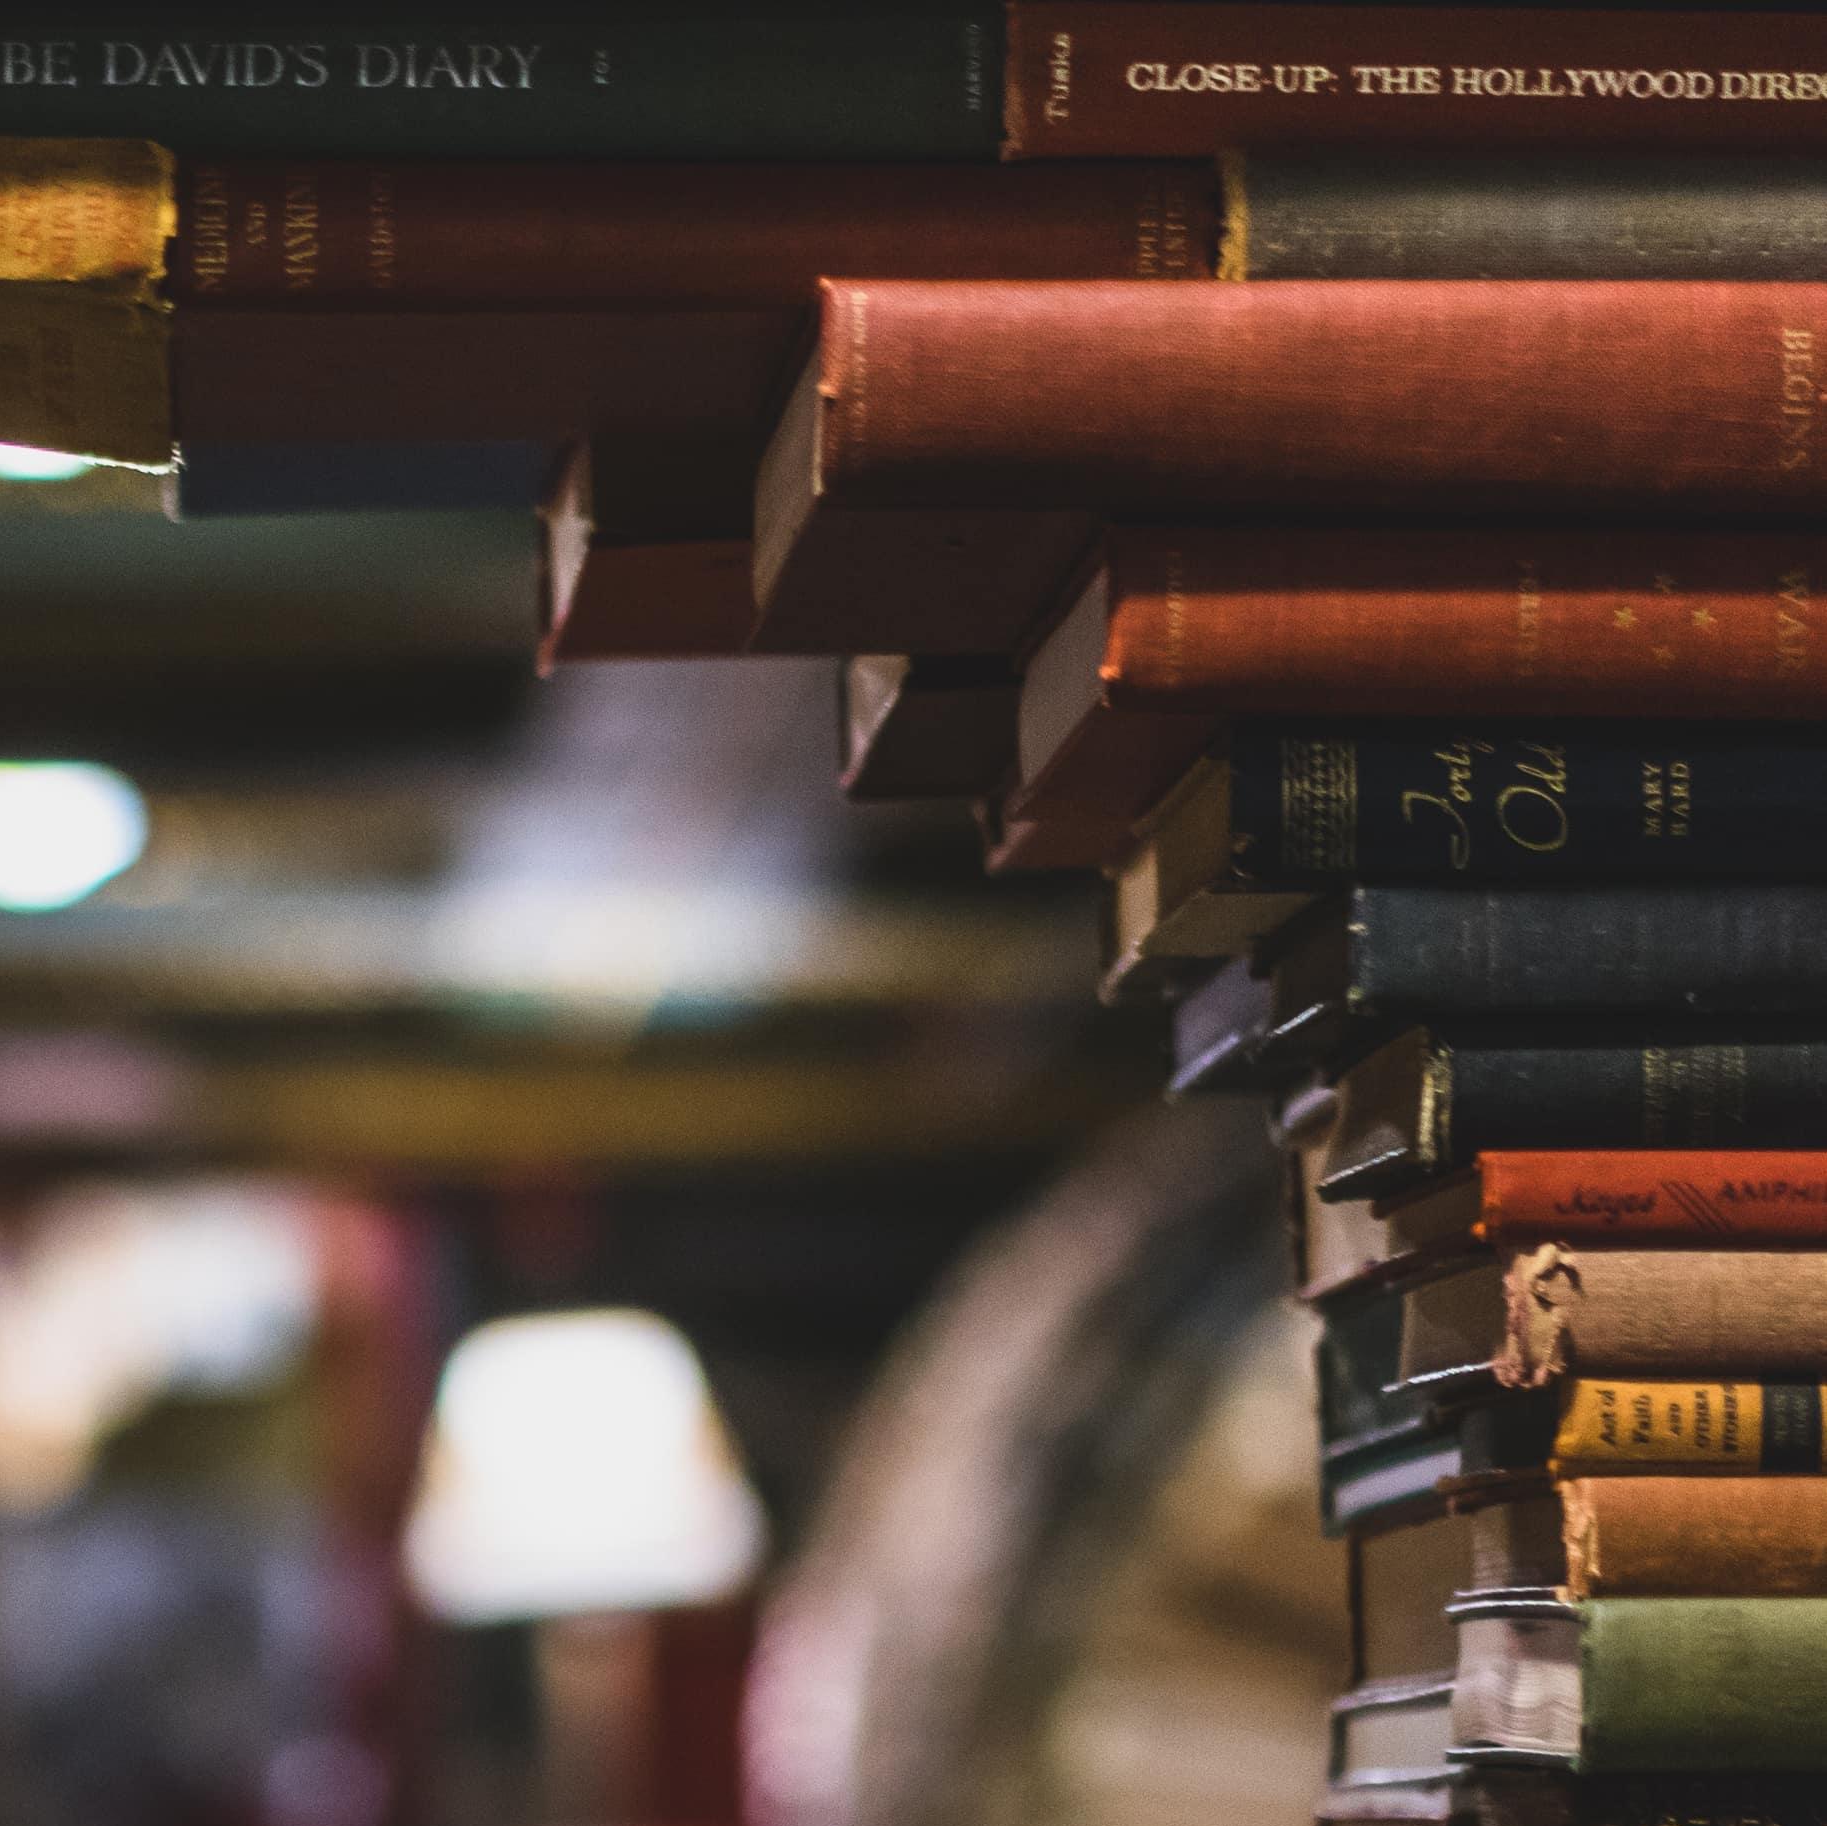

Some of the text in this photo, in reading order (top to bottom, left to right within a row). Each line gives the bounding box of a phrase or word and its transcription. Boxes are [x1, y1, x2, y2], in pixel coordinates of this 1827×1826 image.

[101, 41, 332, 89] DAVID'S
[356, 43, 543, 90] DIARY
[1126, 62, 1338, 94] CLOSE-UP:
[1351, 65, 1442, 96] THE
[1453, 66, 1715, 100] HOLLYWOOD
[1642, 761, 1664, 839] MARY
